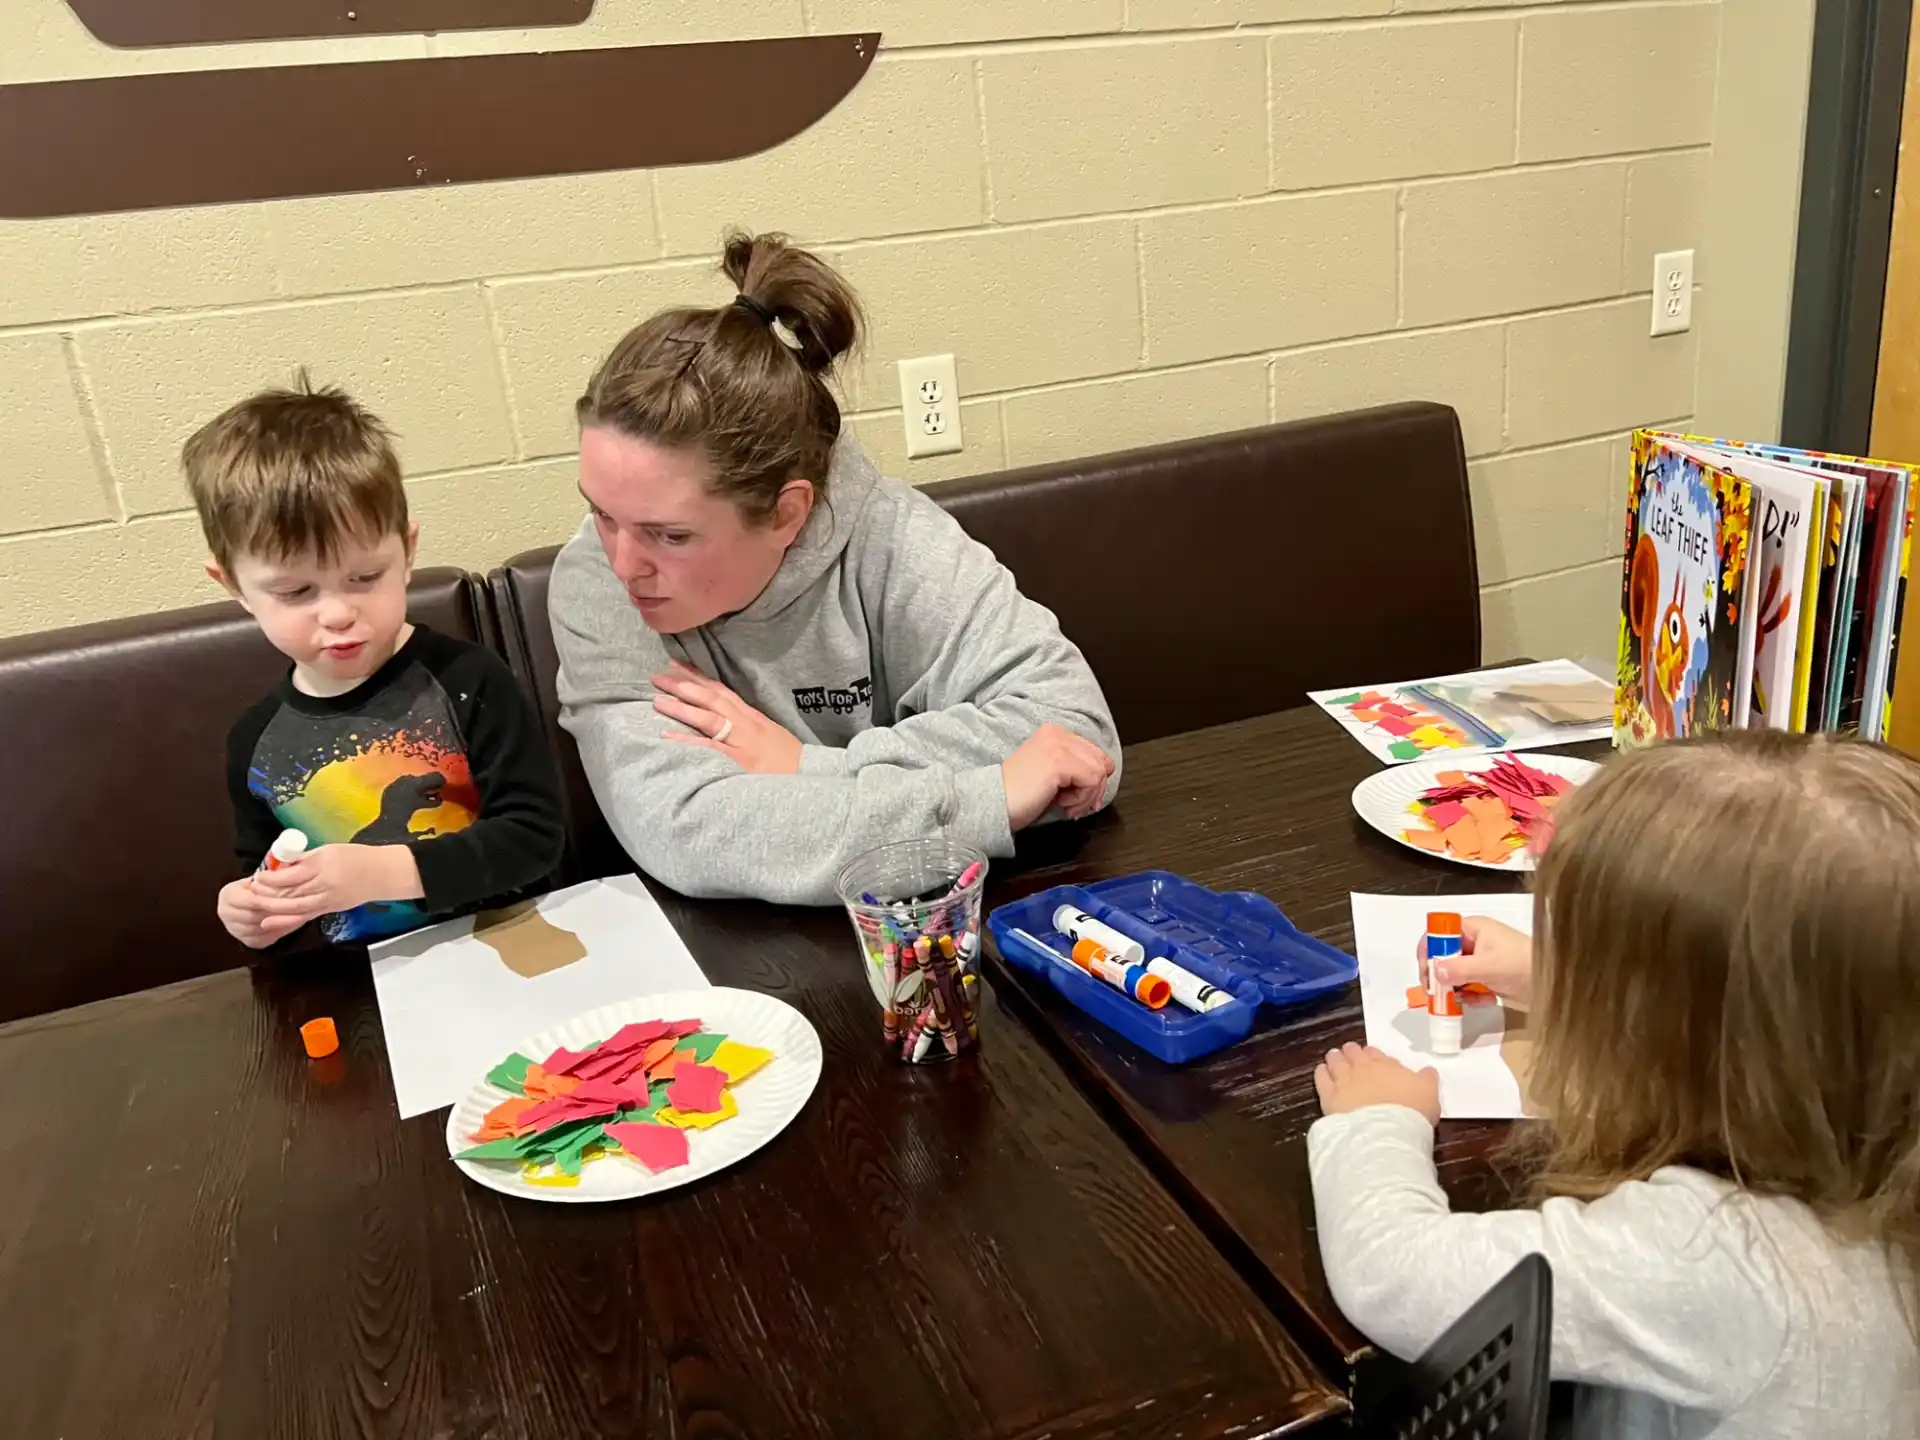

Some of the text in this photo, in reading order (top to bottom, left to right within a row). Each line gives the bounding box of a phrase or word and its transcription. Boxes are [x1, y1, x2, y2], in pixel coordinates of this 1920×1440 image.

[1671, 491, 1684, 517] the
[1651, 504, 1709, 566] LEAF THIEF
[796, 691, 824, 706] TOYS
[830, 693, 854, 705] FOR
